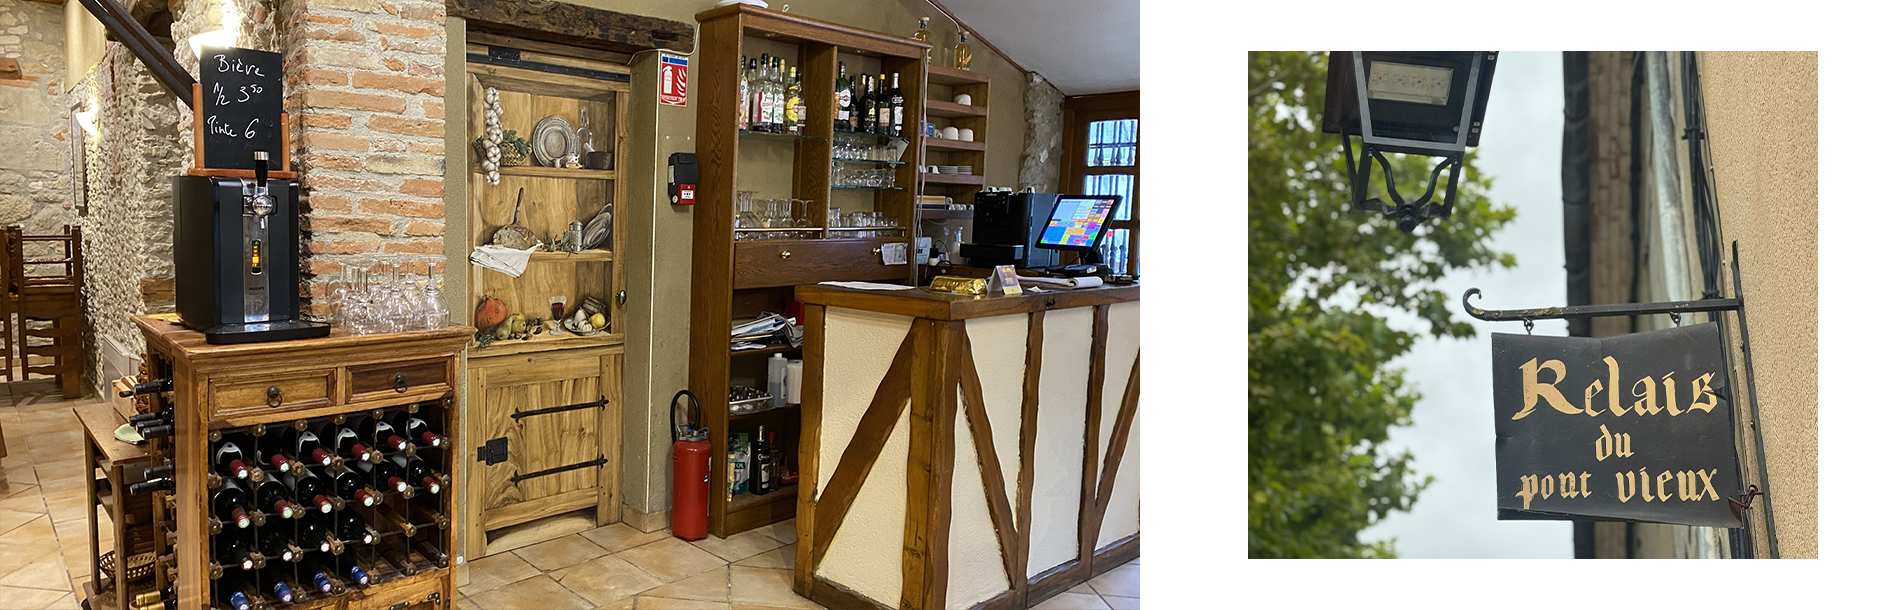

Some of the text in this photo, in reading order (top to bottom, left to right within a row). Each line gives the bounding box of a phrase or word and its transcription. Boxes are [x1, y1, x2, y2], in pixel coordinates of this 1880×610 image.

[213, 54, 265, 76] Bière
[207, 115, 259, 139] Pinte 6
[1511, 355, 1718, 420] Relais
[1595, 424, 1635, 461] du
[1515, 466, 1720, 510] pont vieux
